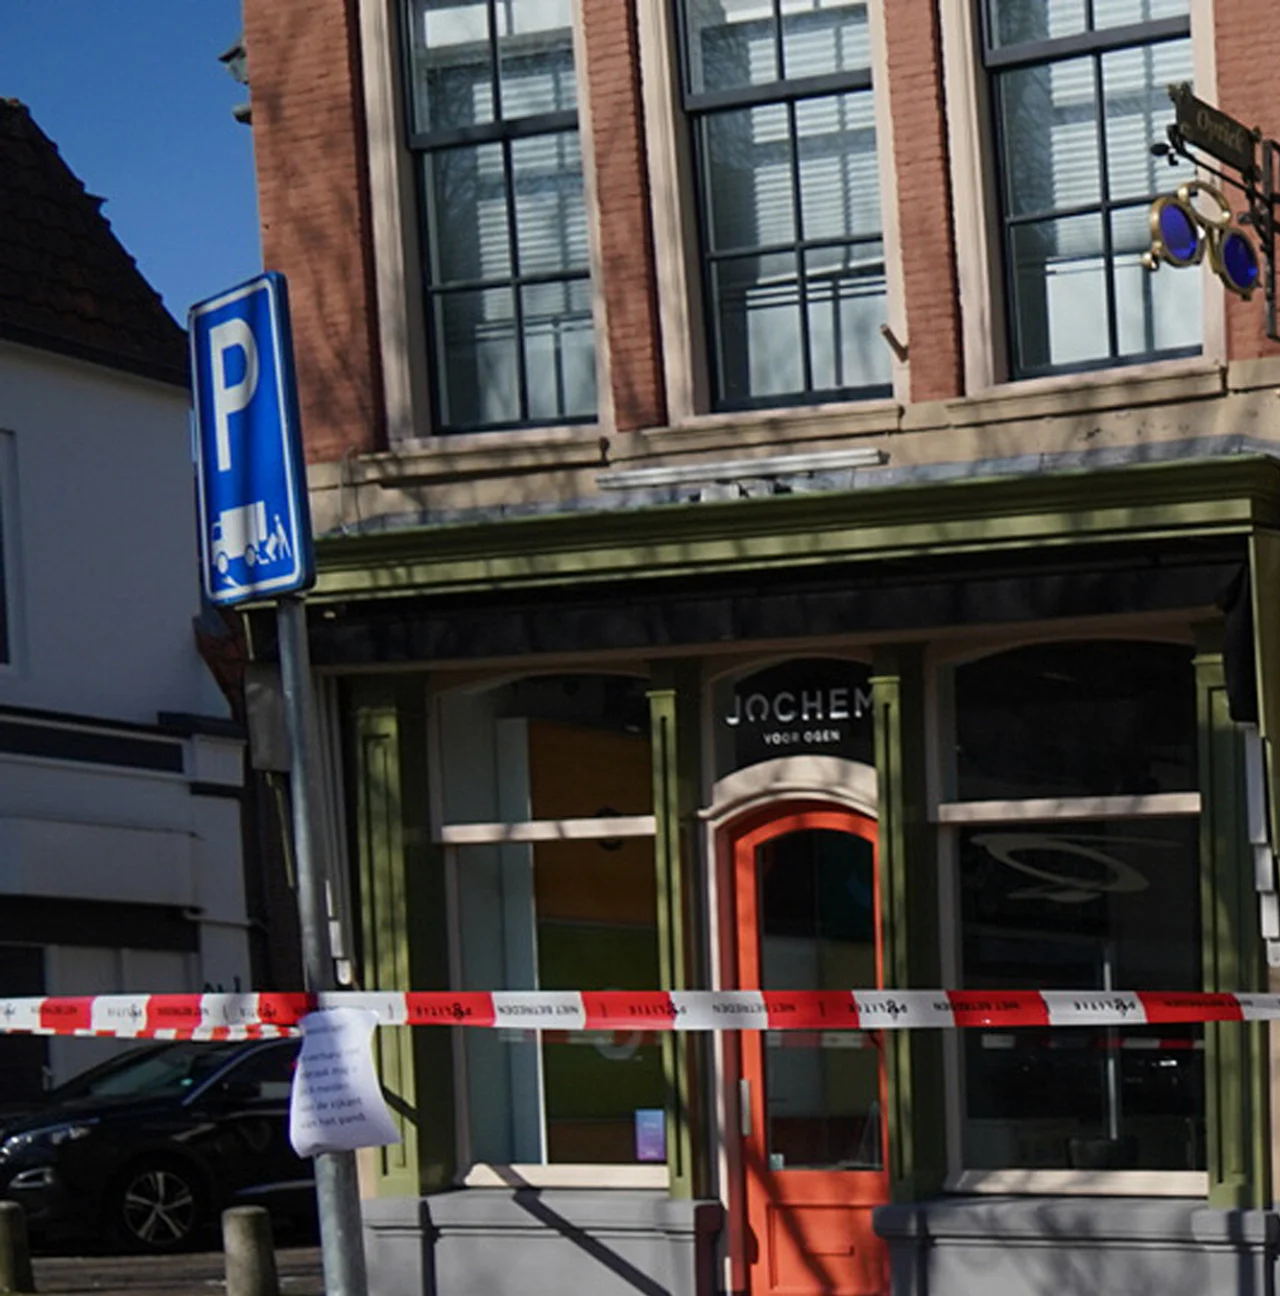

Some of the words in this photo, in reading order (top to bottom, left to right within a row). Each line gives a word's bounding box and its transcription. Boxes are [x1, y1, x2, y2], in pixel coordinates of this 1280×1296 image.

[209, 317, 259, 471] P
[725, 686, 874, 726] JOCHEM
[763, 731, 800, 745] VOOR
[803, 729, 841, 744] OGEN
